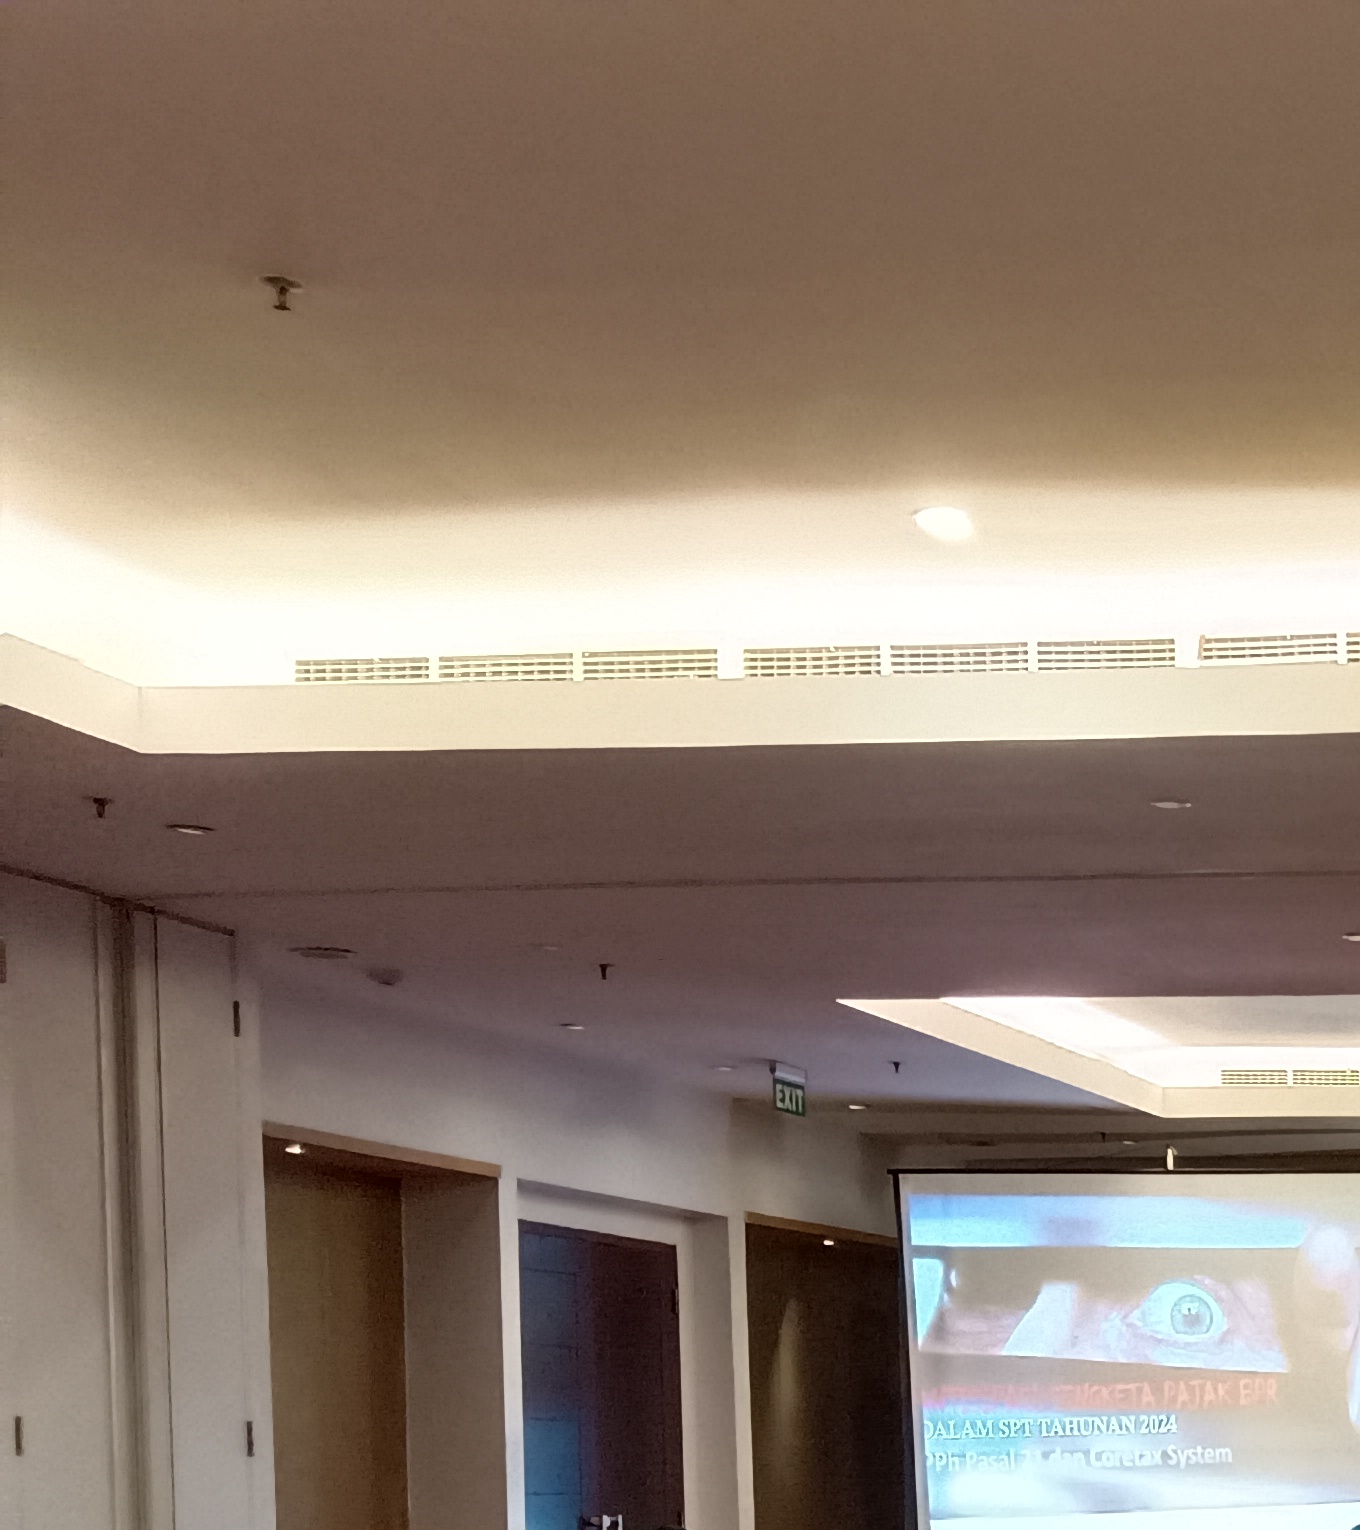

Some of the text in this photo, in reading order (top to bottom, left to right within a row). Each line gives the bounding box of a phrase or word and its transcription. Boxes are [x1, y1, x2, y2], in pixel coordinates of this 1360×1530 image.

[775, 1083, 804, 1113] EXIT
[999, 1418, 1034, 1438] SPT
[1037, 1415, 1137, 1438] TAHUNAN
[1139, 1414, 1178, 1435] 2024
[966, 1447, 1016, 1472] Pasal
[1089, 1447, 1163, 1469] Coretax
[1166, 1444, 1233, 1470] System
